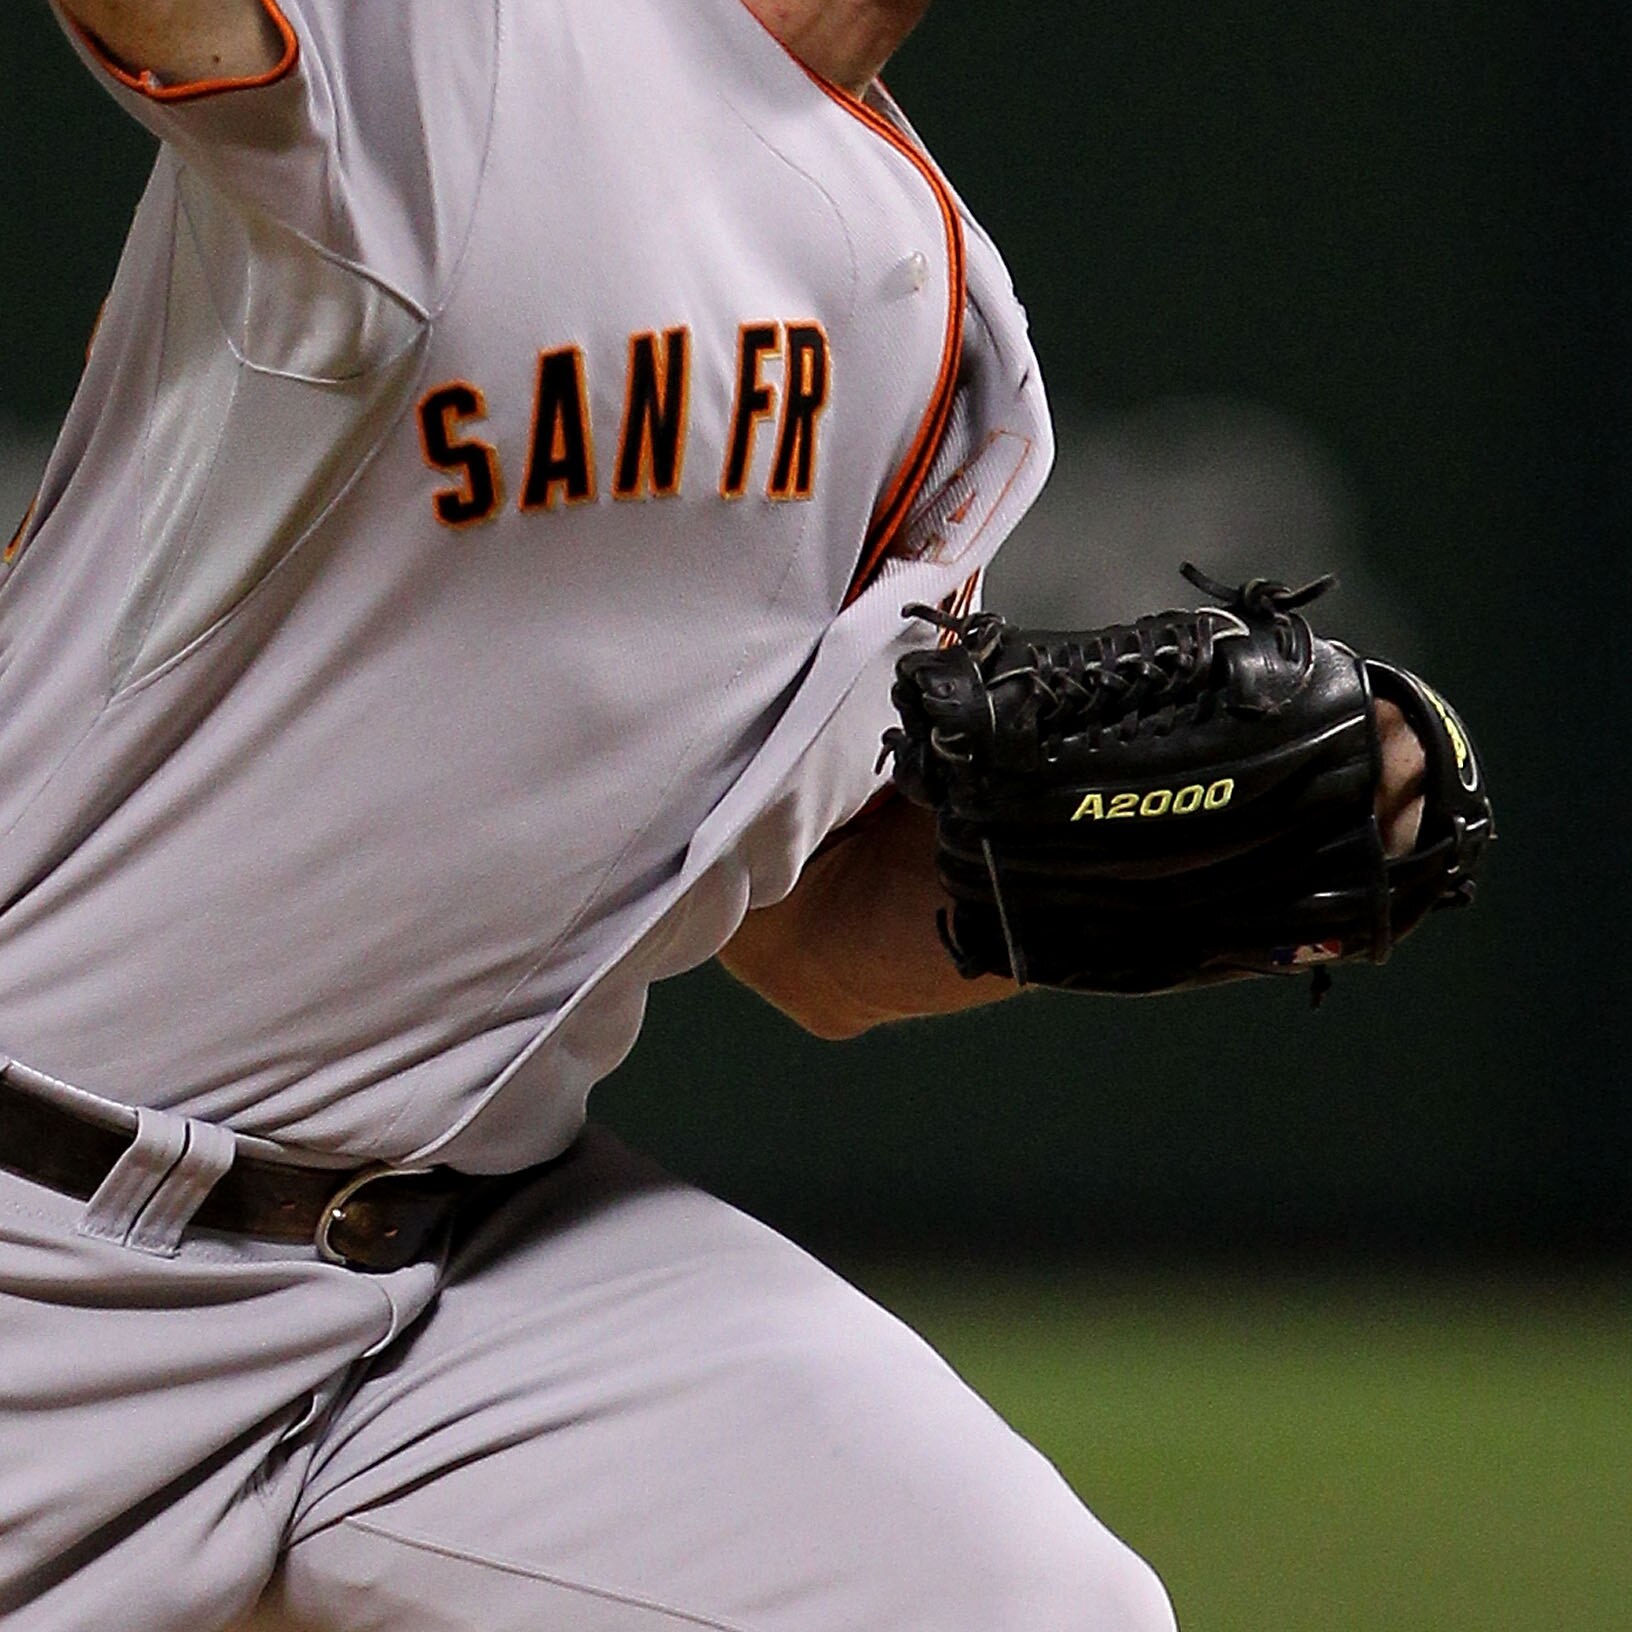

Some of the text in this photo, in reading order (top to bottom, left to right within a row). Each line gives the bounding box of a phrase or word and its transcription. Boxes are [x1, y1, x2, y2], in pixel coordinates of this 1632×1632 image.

[416, 317, 833, 530] SAN FR
[1070, 778, 1235, 822] A2000
